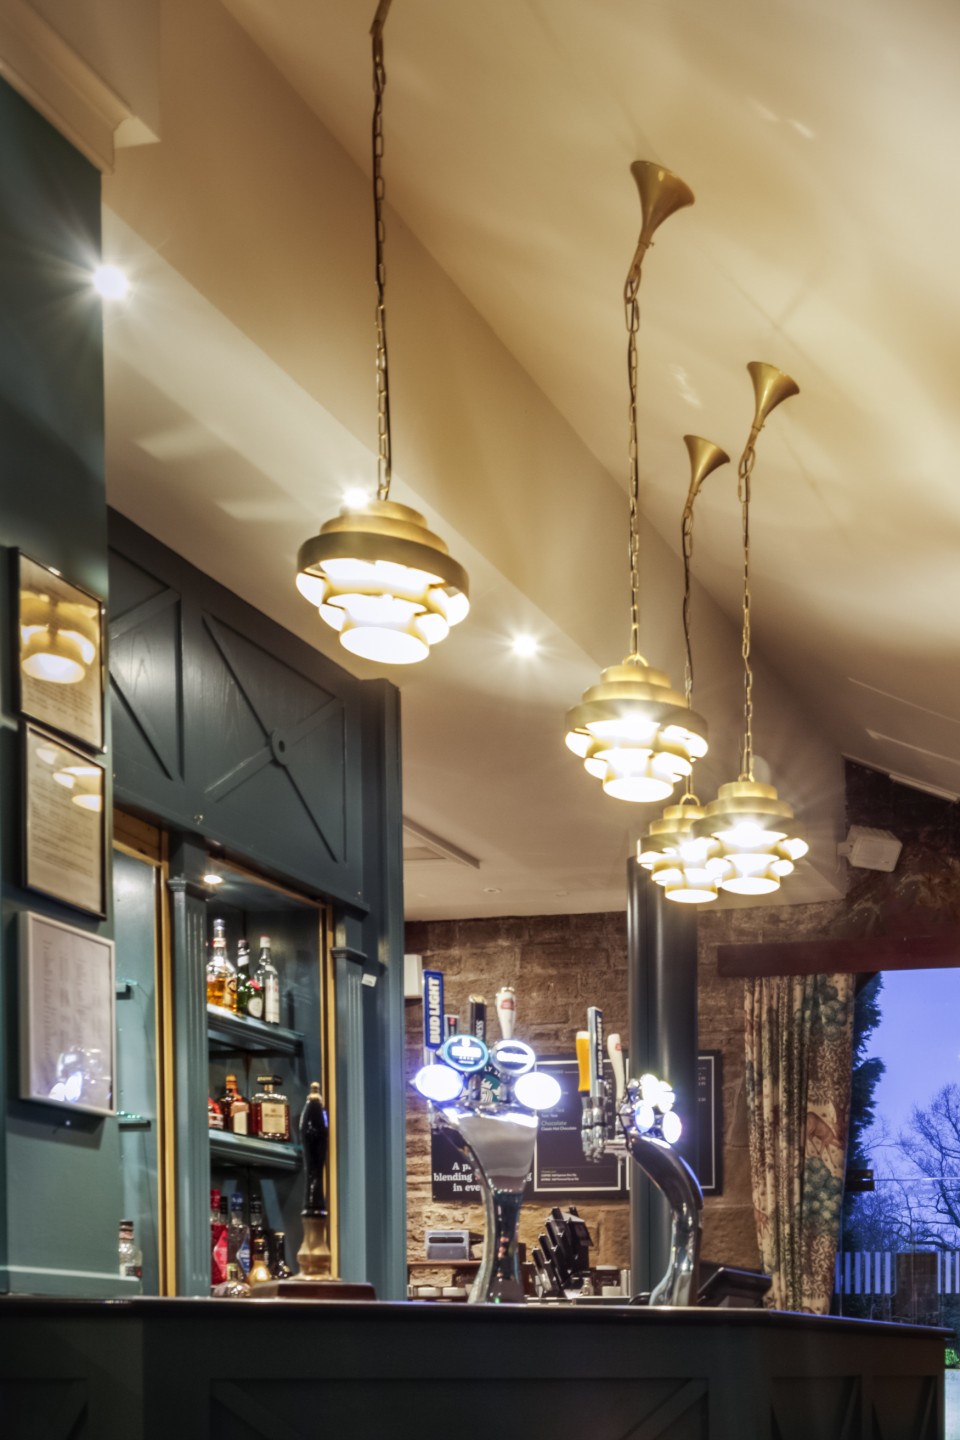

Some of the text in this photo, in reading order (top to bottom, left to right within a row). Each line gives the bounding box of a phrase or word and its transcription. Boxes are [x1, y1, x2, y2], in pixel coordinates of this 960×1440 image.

[428, 977, 441, 1044] BUD LIGHT
[433, 1172, 473, 1183] blending
[452, 1183, 481, 1192] in eve
